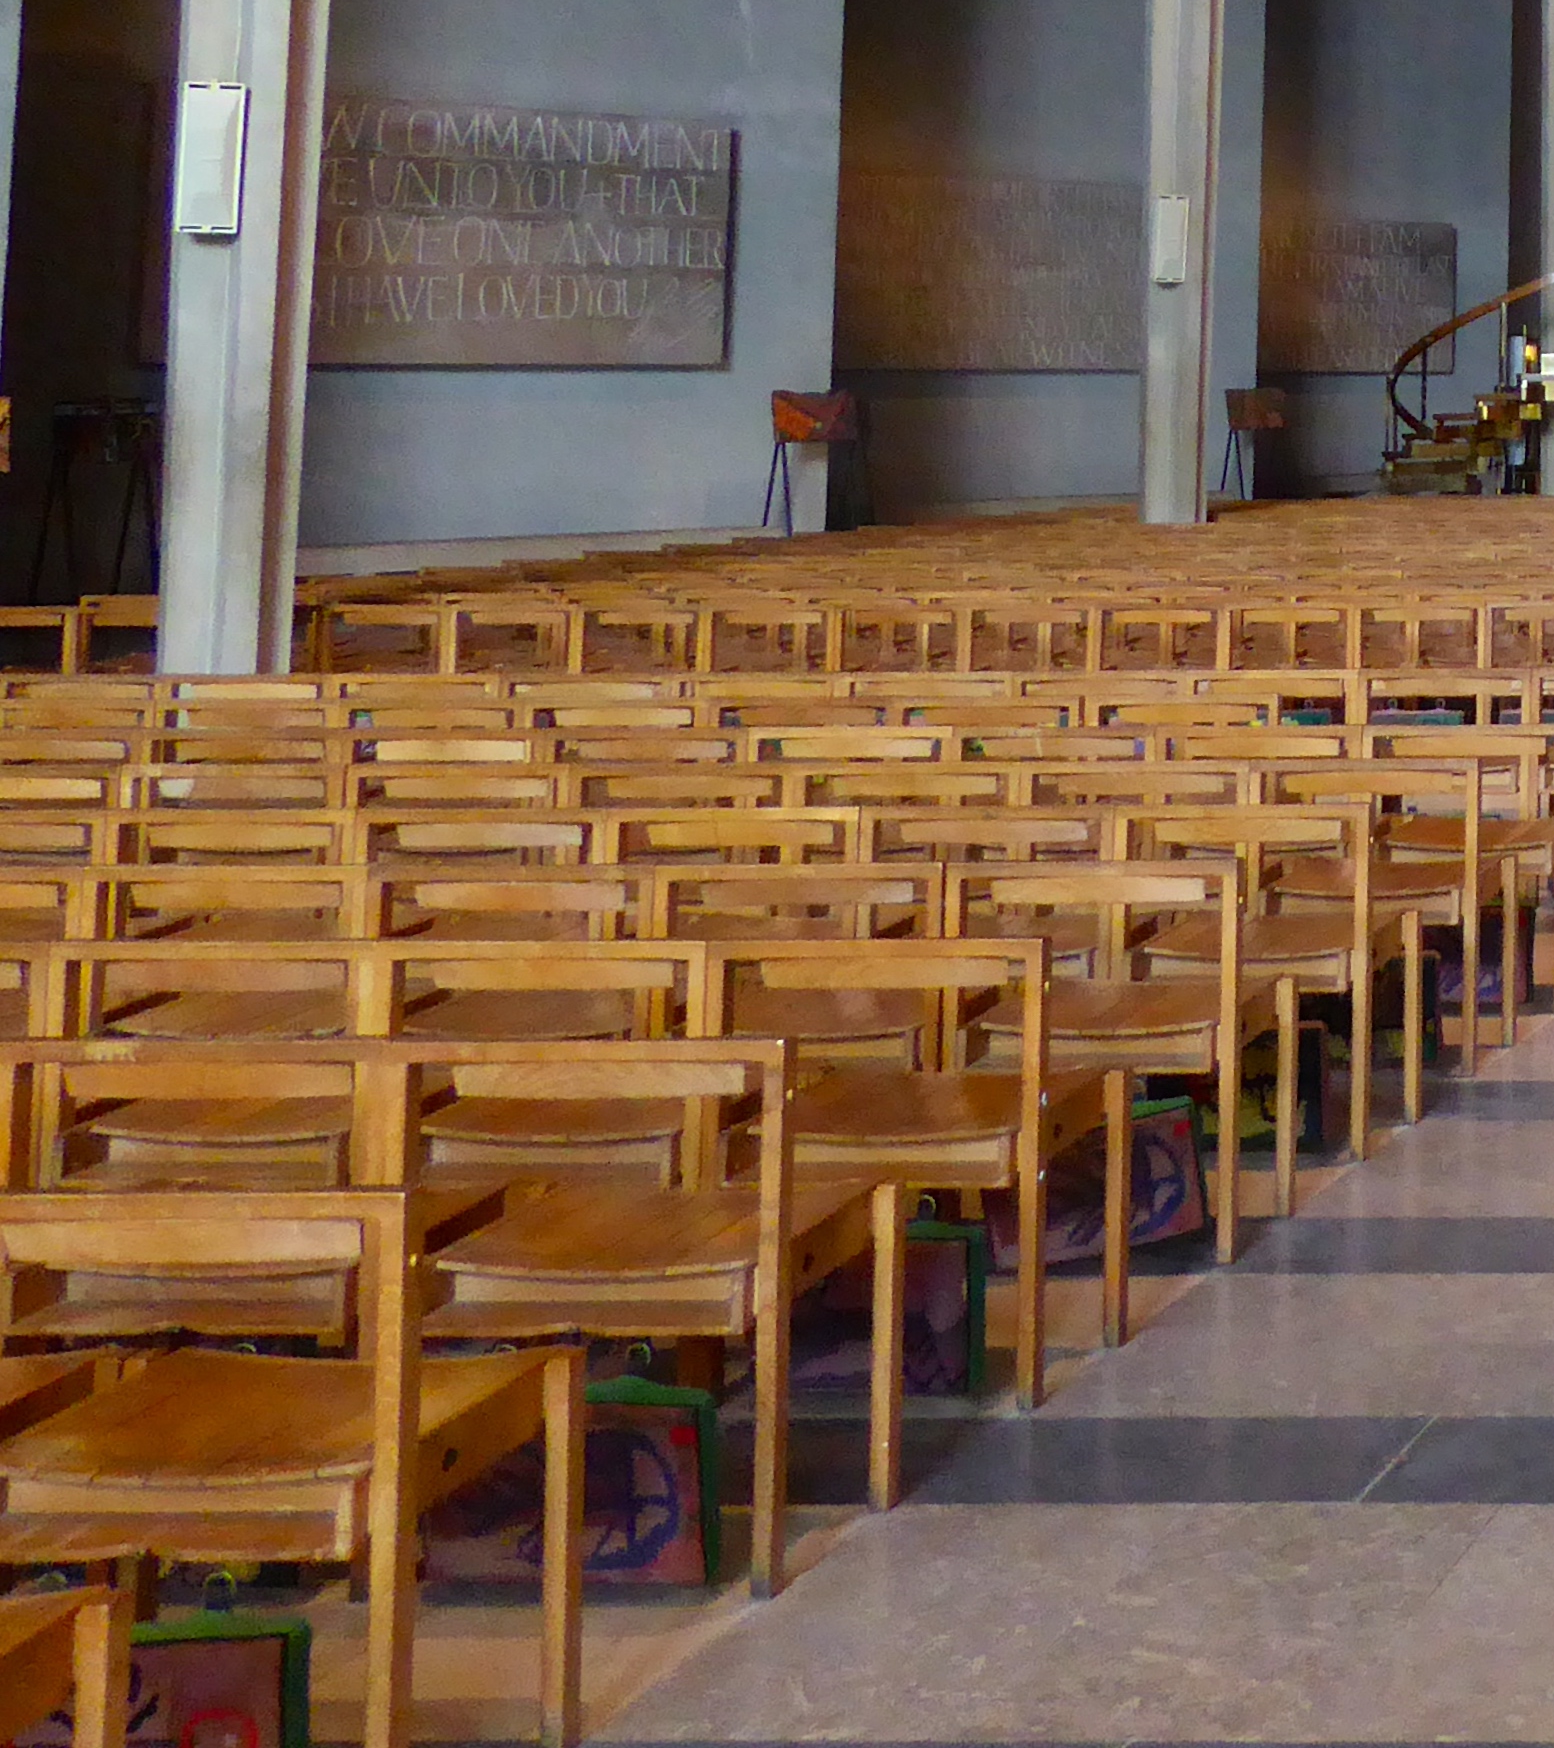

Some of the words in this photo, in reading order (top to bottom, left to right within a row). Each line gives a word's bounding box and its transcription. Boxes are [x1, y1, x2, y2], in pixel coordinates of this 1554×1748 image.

[376, 106, 732, 172] COMMANDMENT
[369, 158, 498, 211] UNTO
[507, 164, 587, 212] YOU
[615, 174, 704, 217] THAT
[322, 215, 446, 268] OVE
[453, 216, 545, 267] ONE
[553, 220, 726, 270] ANOTHER
[347, 274, 449, 326] HAVE
[456, 272, 579, 321] LOVED
[581, 273, 648, 320] YOU
